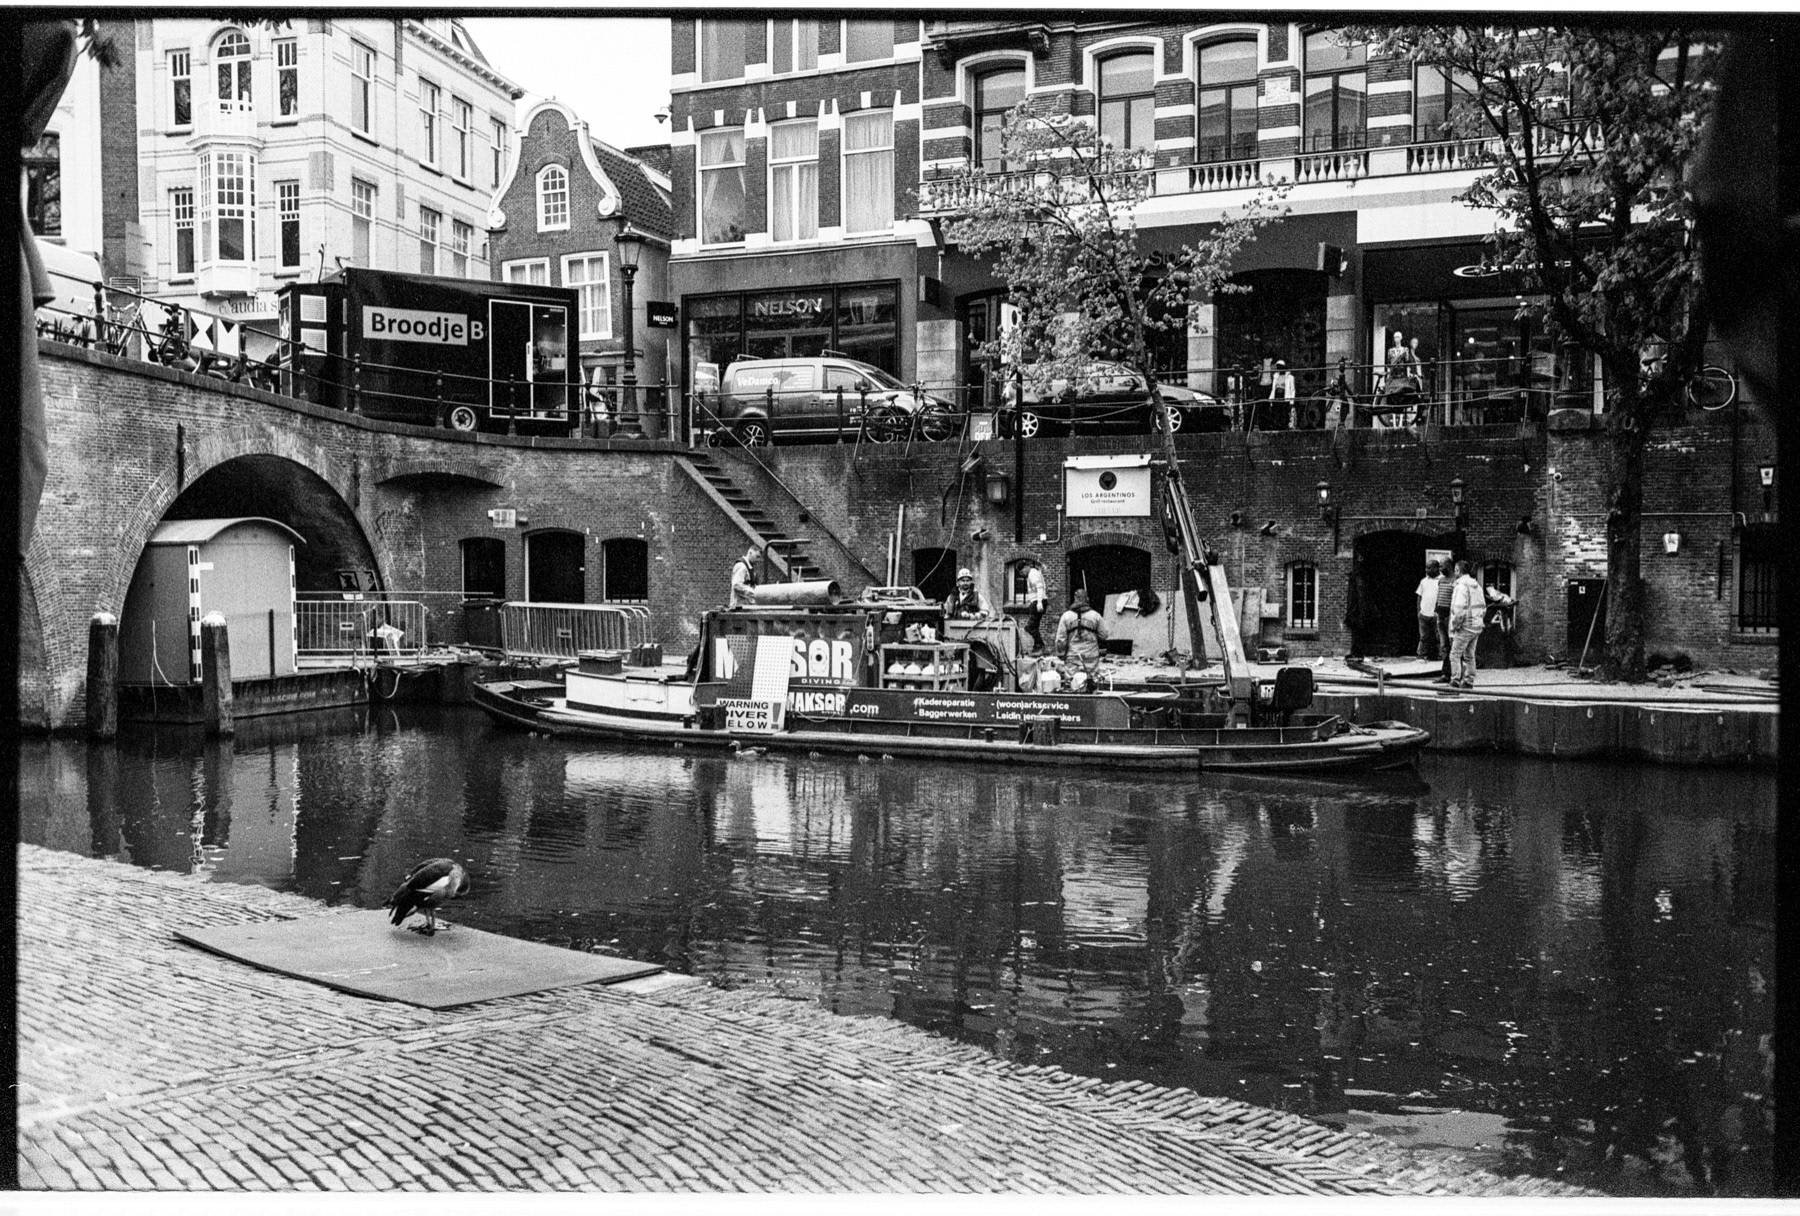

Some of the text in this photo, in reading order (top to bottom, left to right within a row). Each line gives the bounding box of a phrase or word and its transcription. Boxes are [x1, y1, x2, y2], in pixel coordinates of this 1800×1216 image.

[755, 298, 822, 316] NELSON
[652, 314, 674, 323] NELSON
[371, 312, 464, 342] Broodje
[715, 638, 853, 680] MSOR
[720, 700, 769, 710] WARNING
[918, 708, 978, 719] Baggerwerken
[727, 720, 768, 730] ELOW
